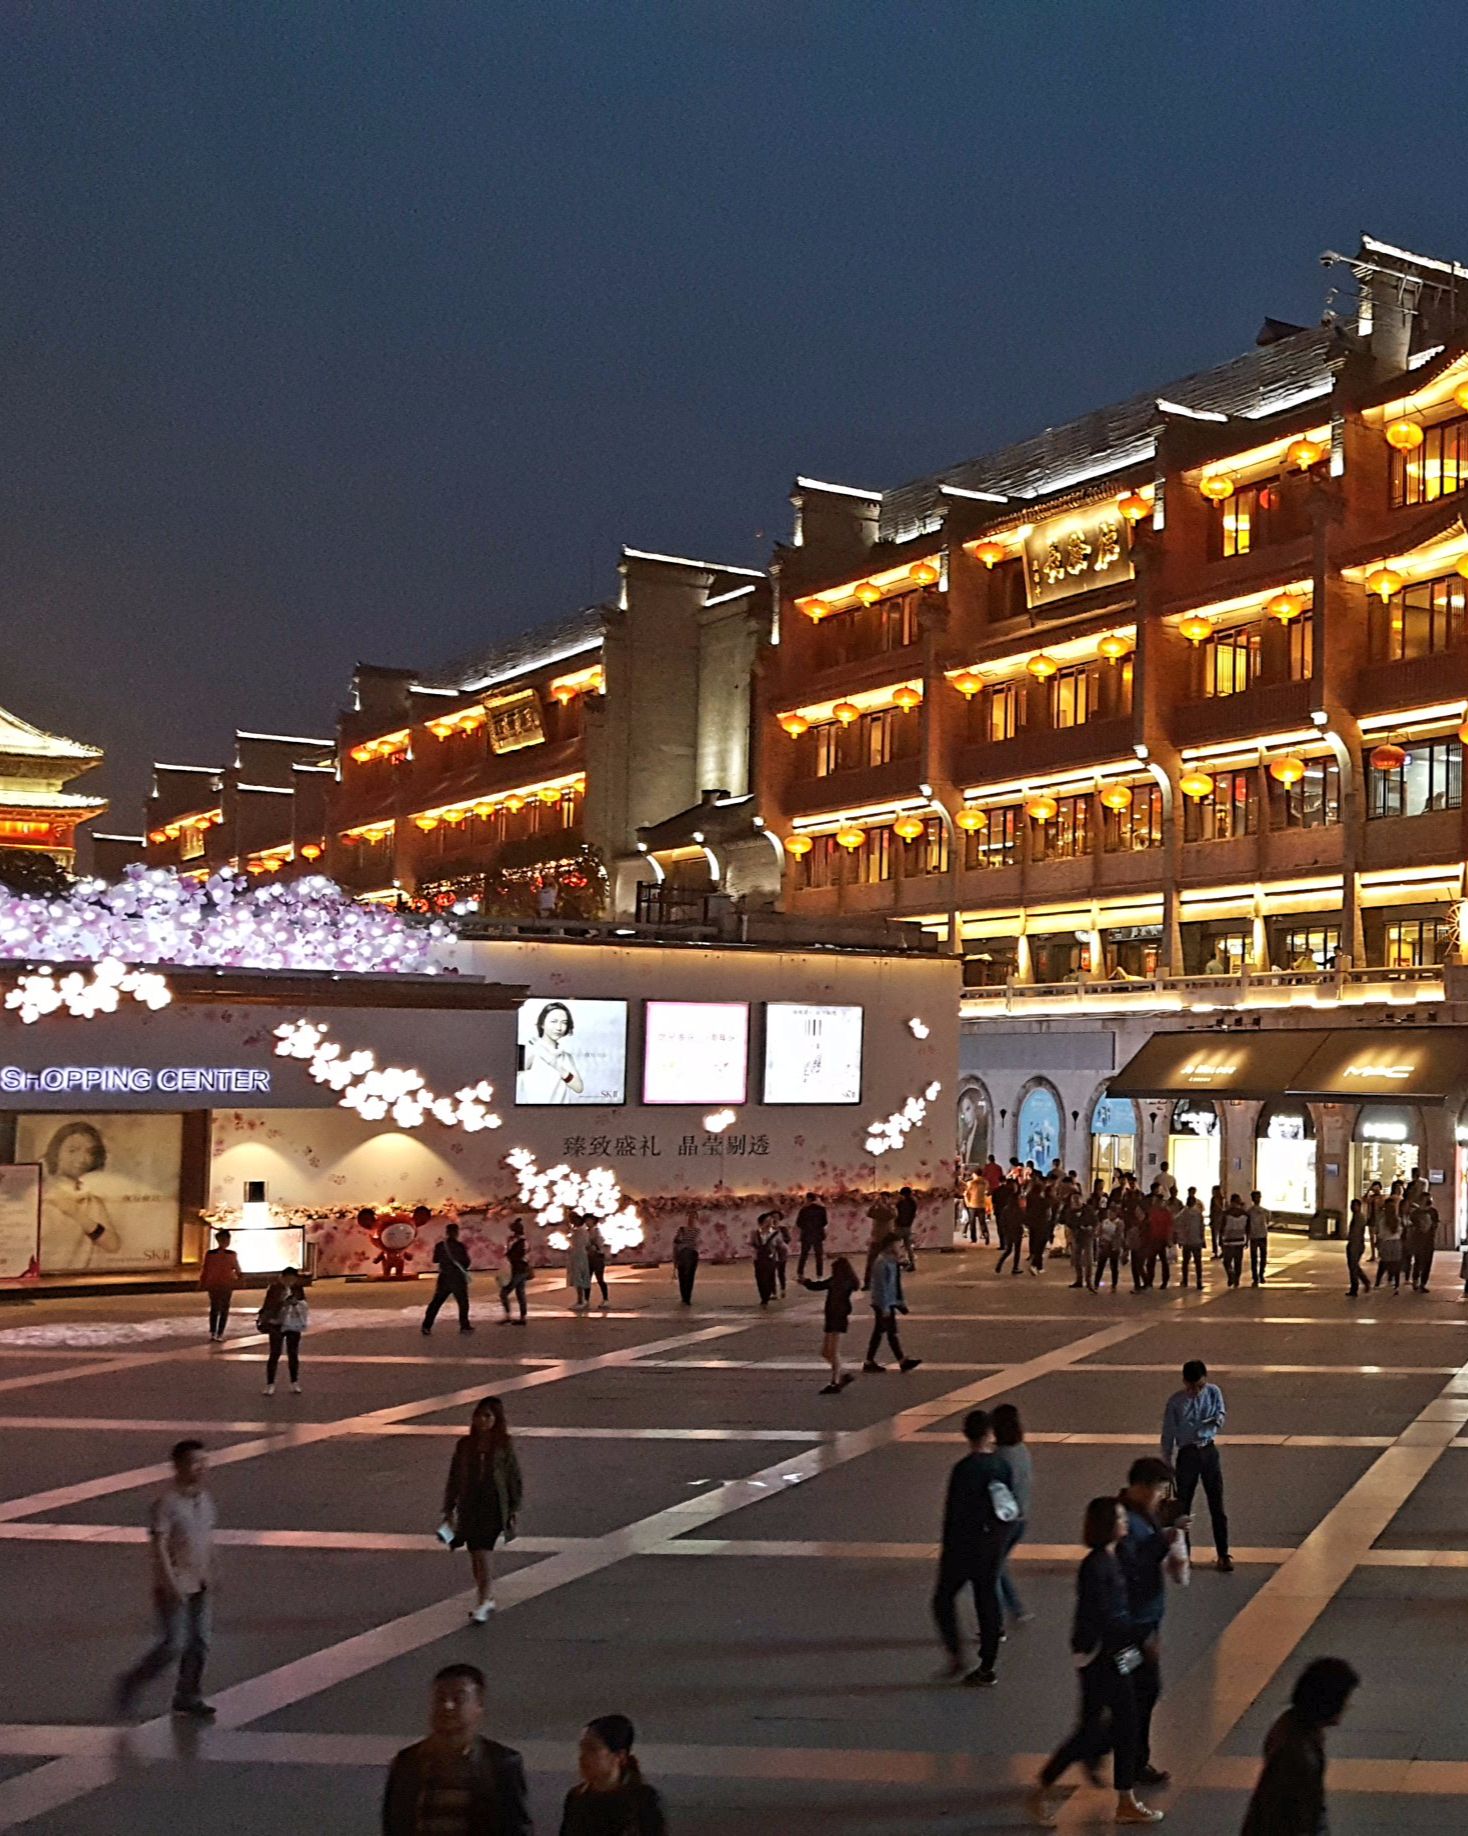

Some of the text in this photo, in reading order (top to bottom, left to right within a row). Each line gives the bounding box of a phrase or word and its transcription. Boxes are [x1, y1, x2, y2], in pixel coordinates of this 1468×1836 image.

[2, 1066, 271, 1092] SHOPPING CENTER
[562, 1135, 770, 1157] 臻致盛礼 晶莹剔透
